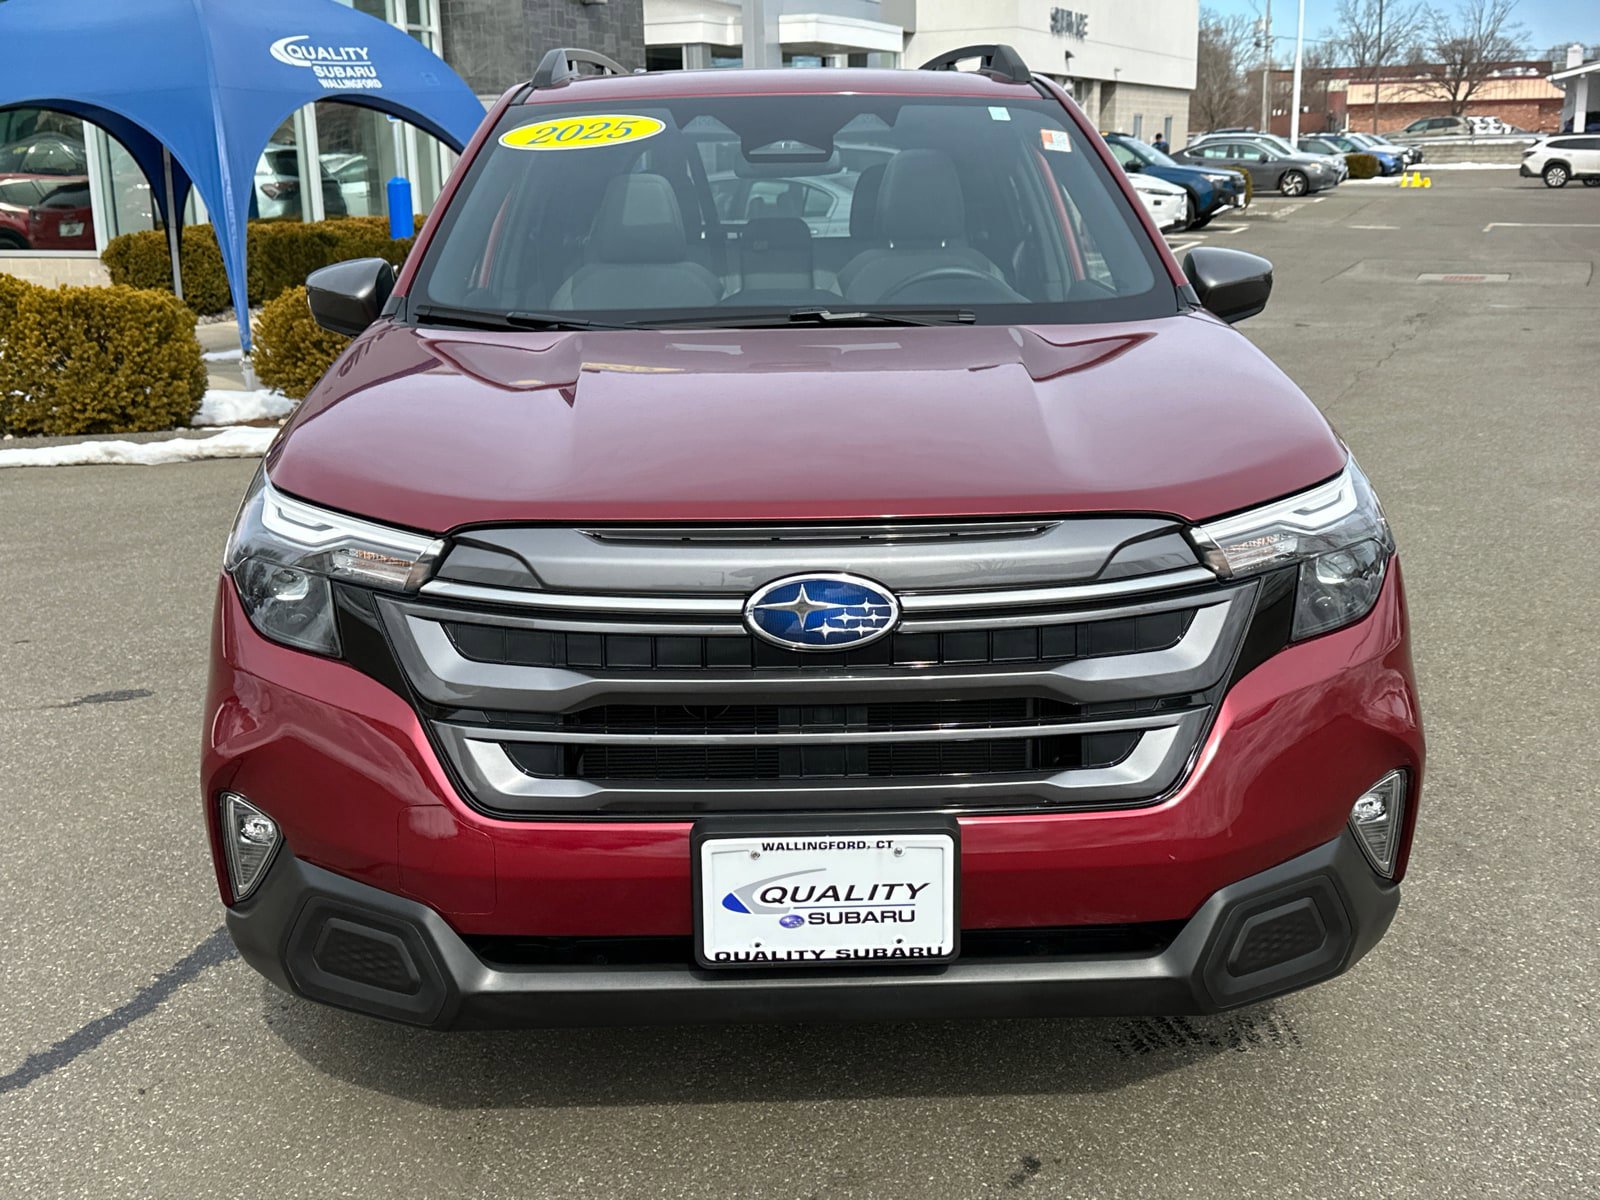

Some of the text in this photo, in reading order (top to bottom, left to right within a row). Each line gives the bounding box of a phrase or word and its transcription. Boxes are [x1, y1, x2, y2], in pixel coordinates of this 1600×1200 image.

[286, 45, 369, 60] QUALITY
[312, 65, 377, 78] SUBARU
[526, 120, 640, 145] 2025
[761, 840, 894, 851] WALLINGFORD, CT
[759, 882, 931, 904] QUALITY
[808, 910, 916, 925] SUBARU
[714, 946, 943, 962] QUALITY SUBARU
